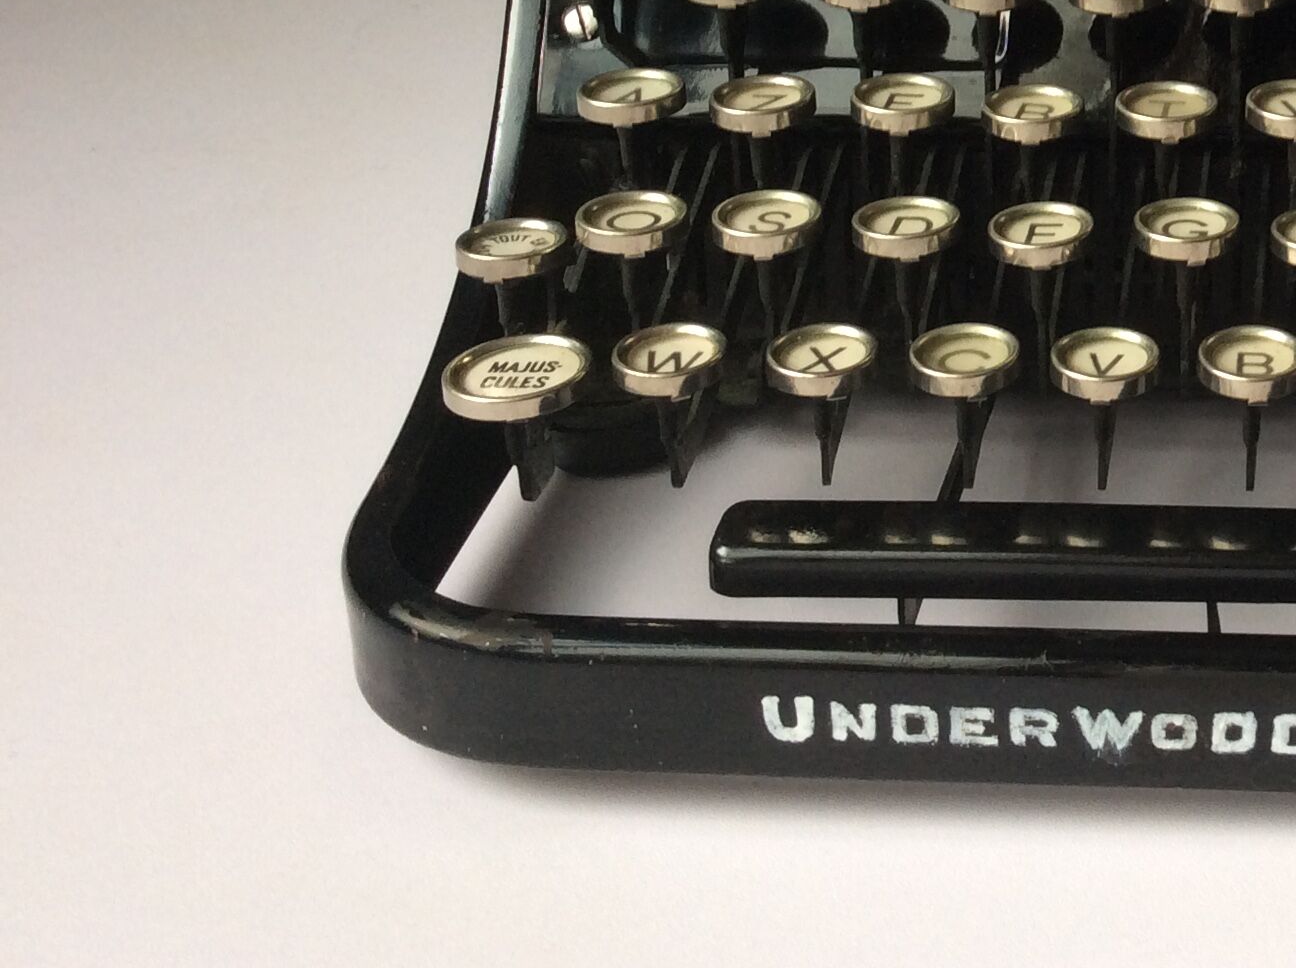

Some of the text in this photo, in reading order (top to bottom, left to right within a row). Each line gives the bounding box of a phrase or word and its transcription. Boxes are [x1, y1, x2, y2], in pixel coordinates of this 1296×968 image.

[883, 93, 923, 111] E
[1149, 100, 1186, 118] T
[748, 211, 792, 234] S
[887, 216, 934, 237] D
[1023, 222, 1064, 244] F
[1161, 219, 1209, 240] G
[491, 234, 532, 245] TOUT
[799, 346, 848, 373] X
[937, 349, 992, 373] C
[1090, 352, 1125, 377] V
[1235, 352, 1274, 377] B
[479, 375, 550, 390] CULES
